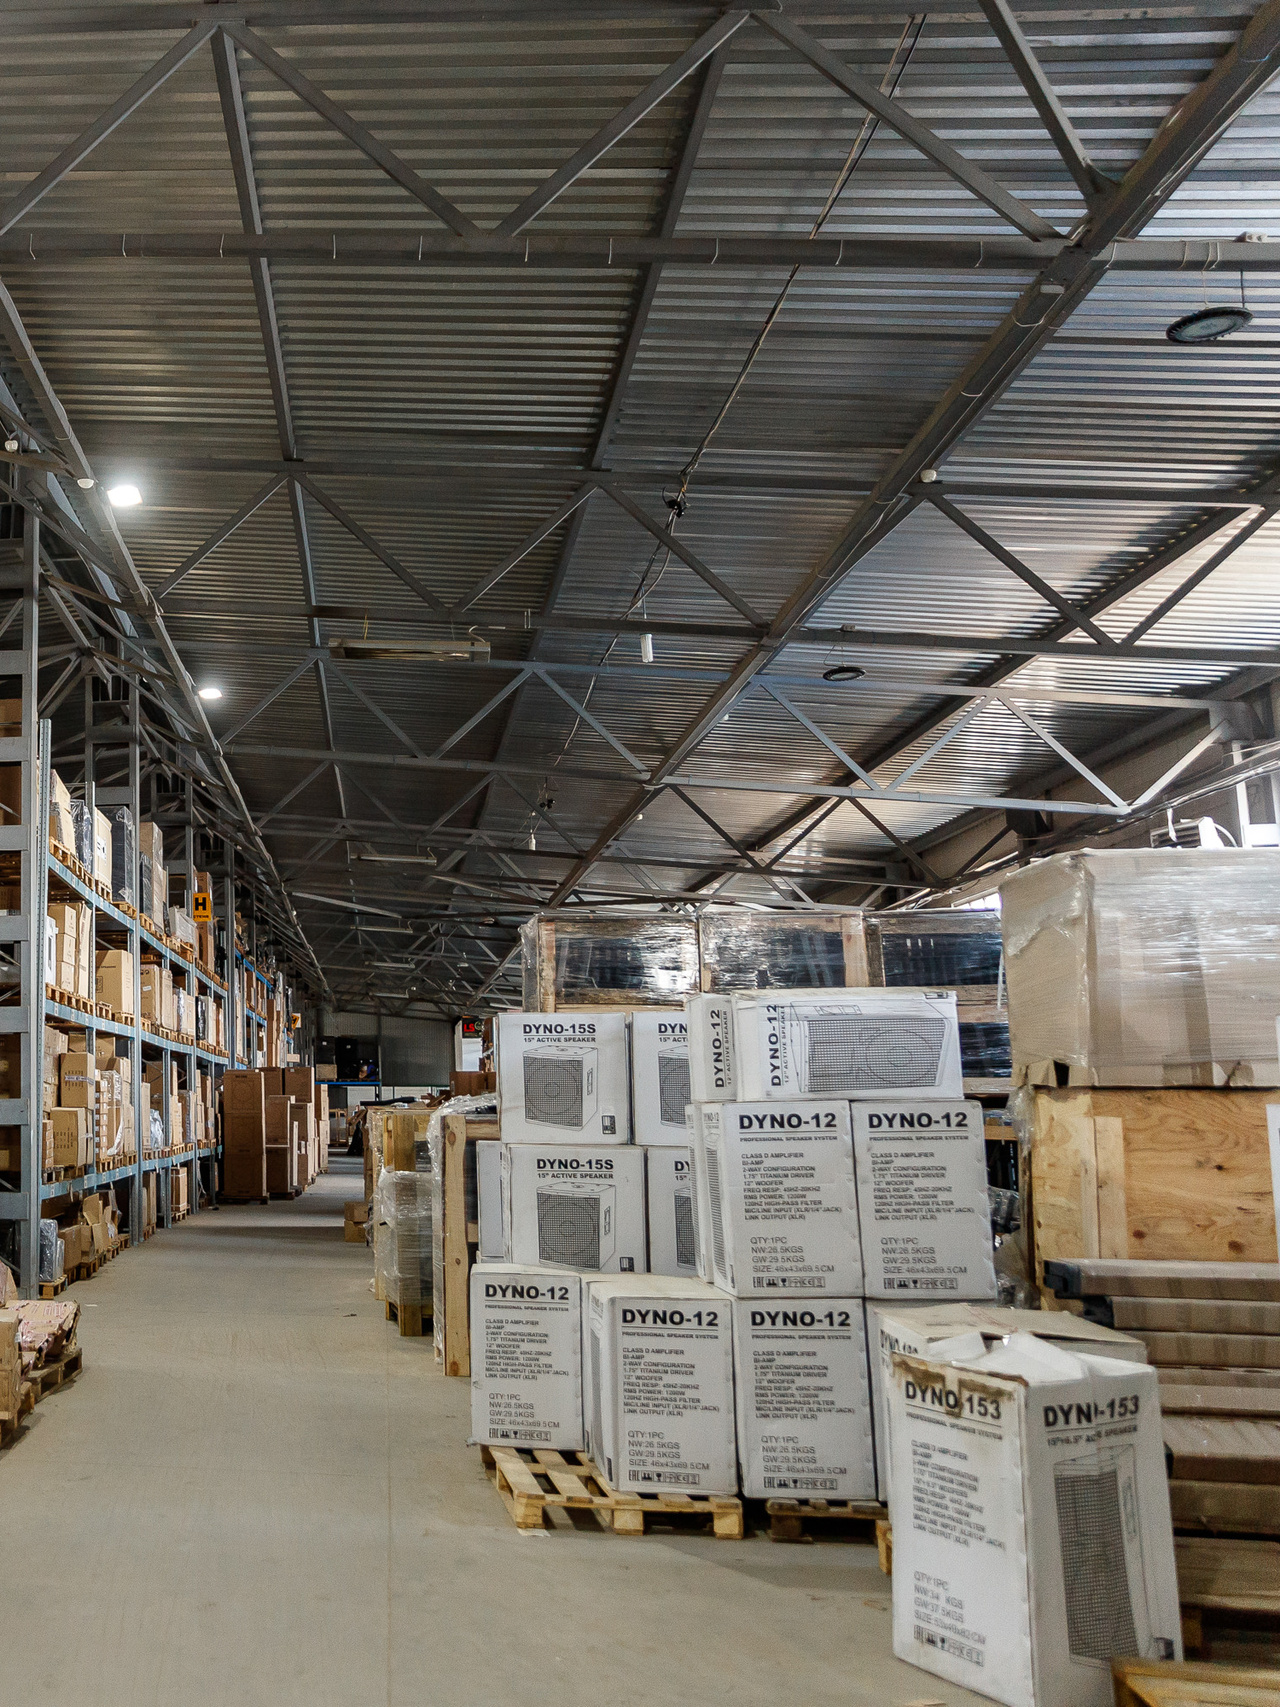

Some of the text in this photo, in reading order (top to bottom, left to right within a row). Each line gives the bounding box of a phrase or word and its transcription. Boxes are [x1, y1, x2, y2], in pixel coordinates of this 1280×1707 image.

[523, 1023, 596, 1034] DYNO-15S
[710, 1009, 725, 1088] DYNO-12
[766, 1004, 782, 1087] DYNO-12
[739, 1112, 837, 1130] DYNO-12
[868, 1112, 968, 1129] DYNO-12
[536, 1158, 614, 1170] DYNO-15S
[485, 1283, 569, 1301] DYNO-12
[621, 1308, 719, 1327] DYNO-12
[750, 1310, 851, 1327] DYNO-12
[643, 1361, 695, 1369] CONFIGURATION
[639, 1408, 665, 1416] OUTPUT
